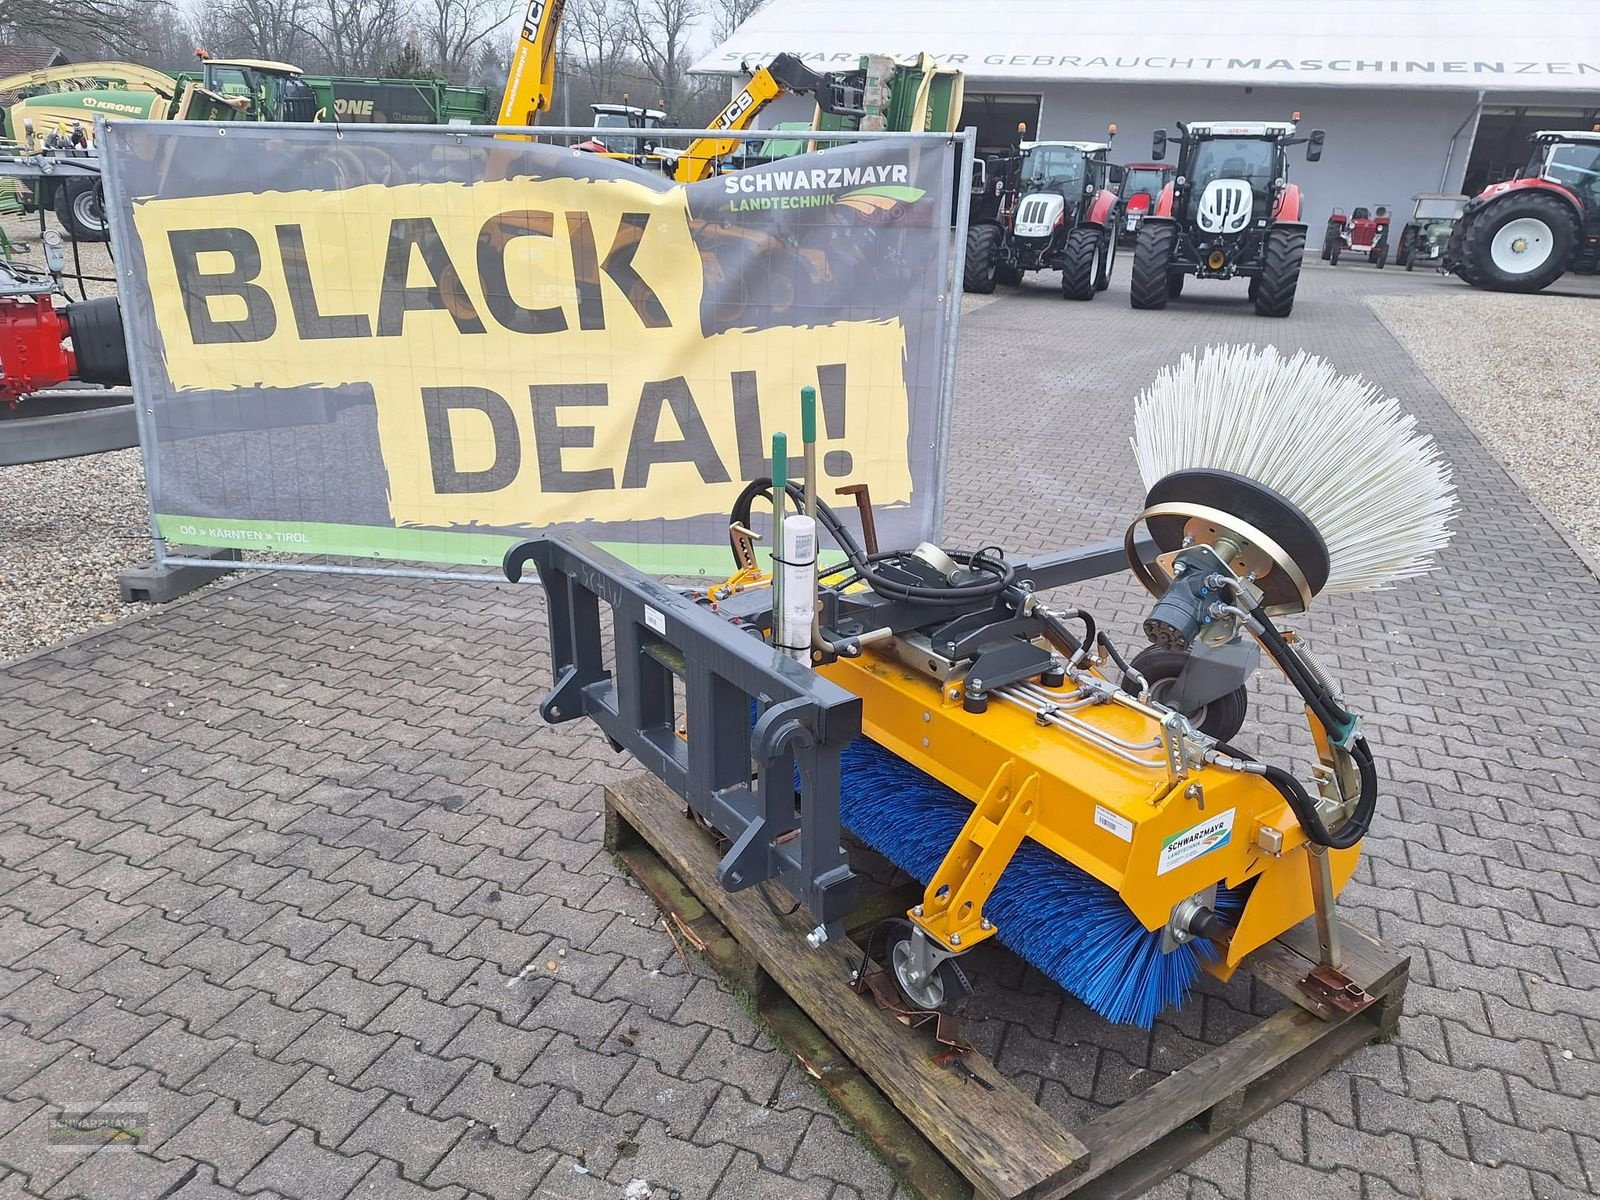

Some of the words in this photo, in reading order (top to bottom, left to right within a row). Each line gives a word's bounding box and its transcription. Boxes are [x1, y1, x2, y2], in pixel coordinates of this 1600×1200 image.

[97, 101, 143, 114] KRONE
[720, 91, 753, 130] JCB
[725, 164, 907, 193] SCHWARZMAYR
[730, 194, 836, 213] LANDTECHNIK
[168, 209, 672, 345] BLACK
[421, 364, 853, 496] DEAL!
[180, 525, 197, 537] OÖ
[208, 527, 263, 541] KÄRNTEN
[275, 532, 309, 544] TIROL
[1168, 821, 1224, 853] SCHWARZMAYR
